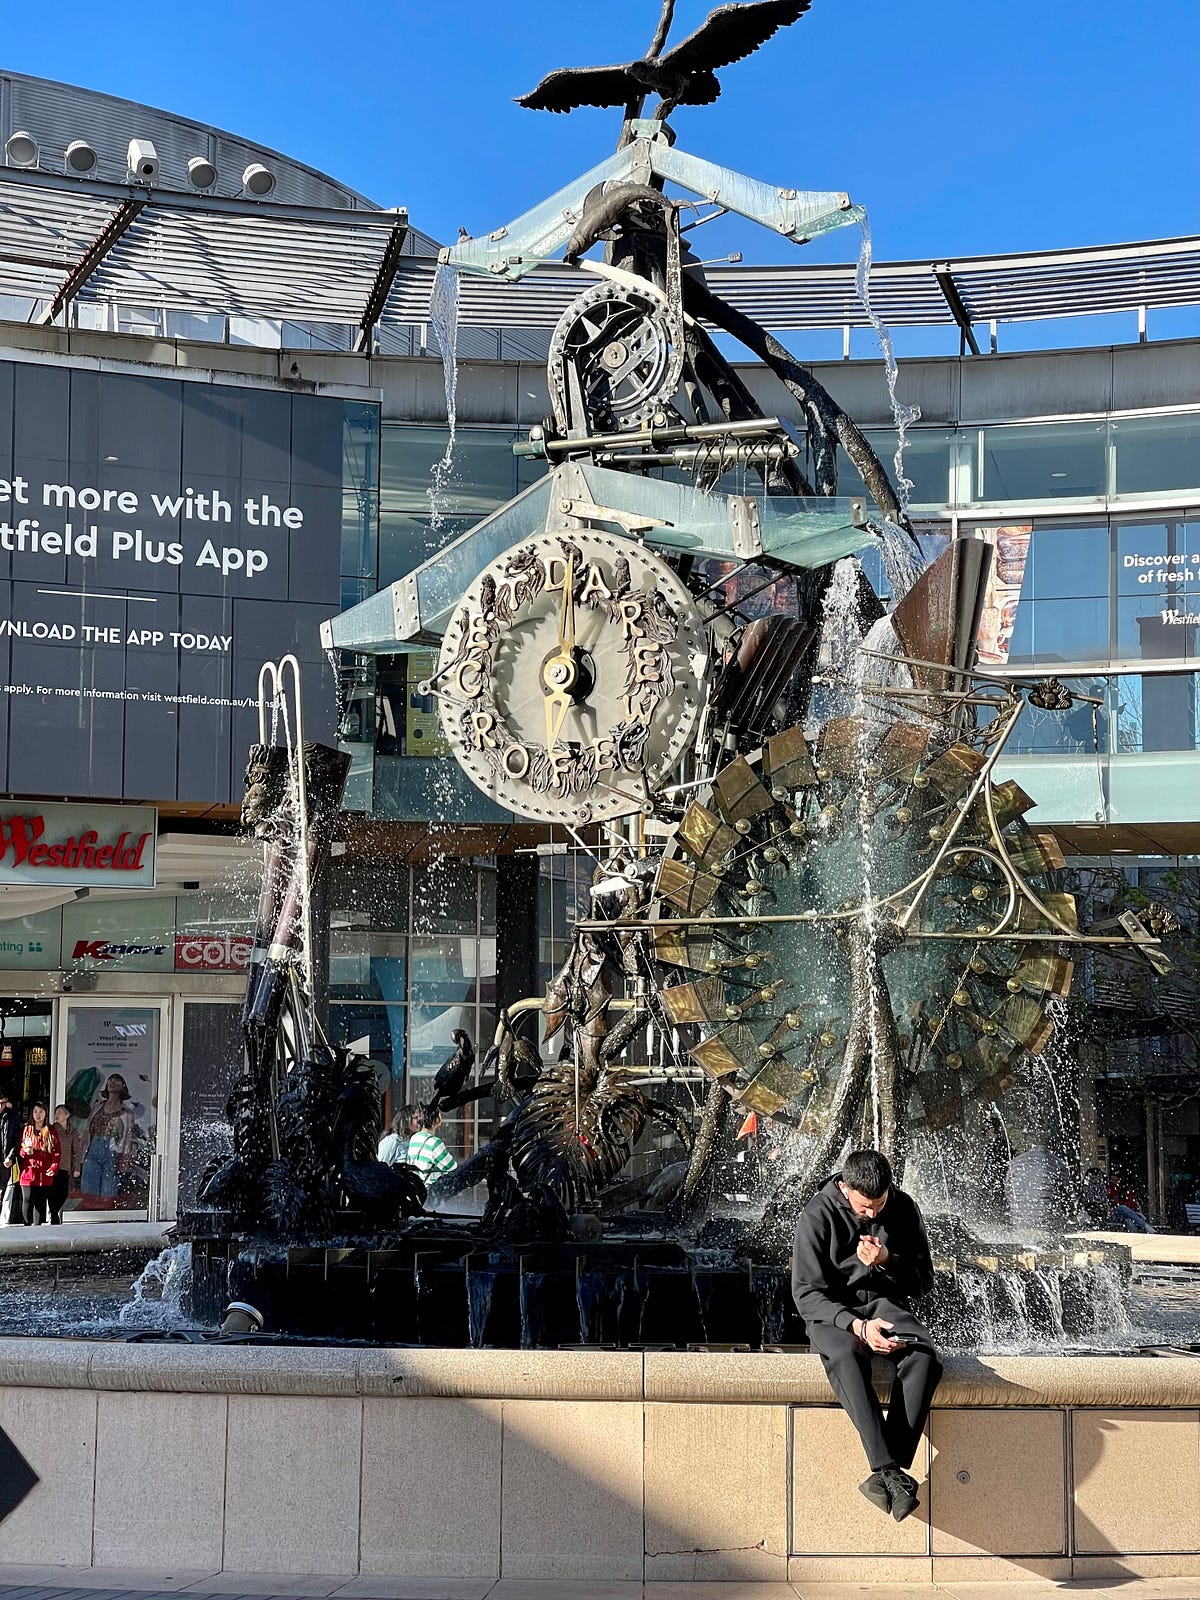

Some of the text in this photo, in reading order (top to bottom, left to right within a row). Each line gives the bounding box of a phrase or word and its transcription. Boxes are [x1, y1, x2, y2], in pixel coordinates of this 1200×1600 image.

[42, 482, 139, 514] more
[150, 487, 232, 523] with
[244, 495, 304, 529] the
[112, 529, 184, 565] Plus
[195, 539, 269, 578] App
[1123, 553, 1188, 568] Discover
[1138, 569, 1154, 583] of
[1156, 567, 1194, 583] fresh
[82, 626, 121, 644] THE
[126, 629, 164, 647] APP
[169, 632, 232, 651] TODAY
[4, 683, 34, 695] apply.
[36, 685, 52, 695] For
[55, 687, 81, 697] more
[83, 687, 139, 700] information
[141, 691, 161, 702] visit
[0, 815, 153, 871] Westfield
[72, 940, 166, 960] Kmart
[181, 931, 251, 965] cole
